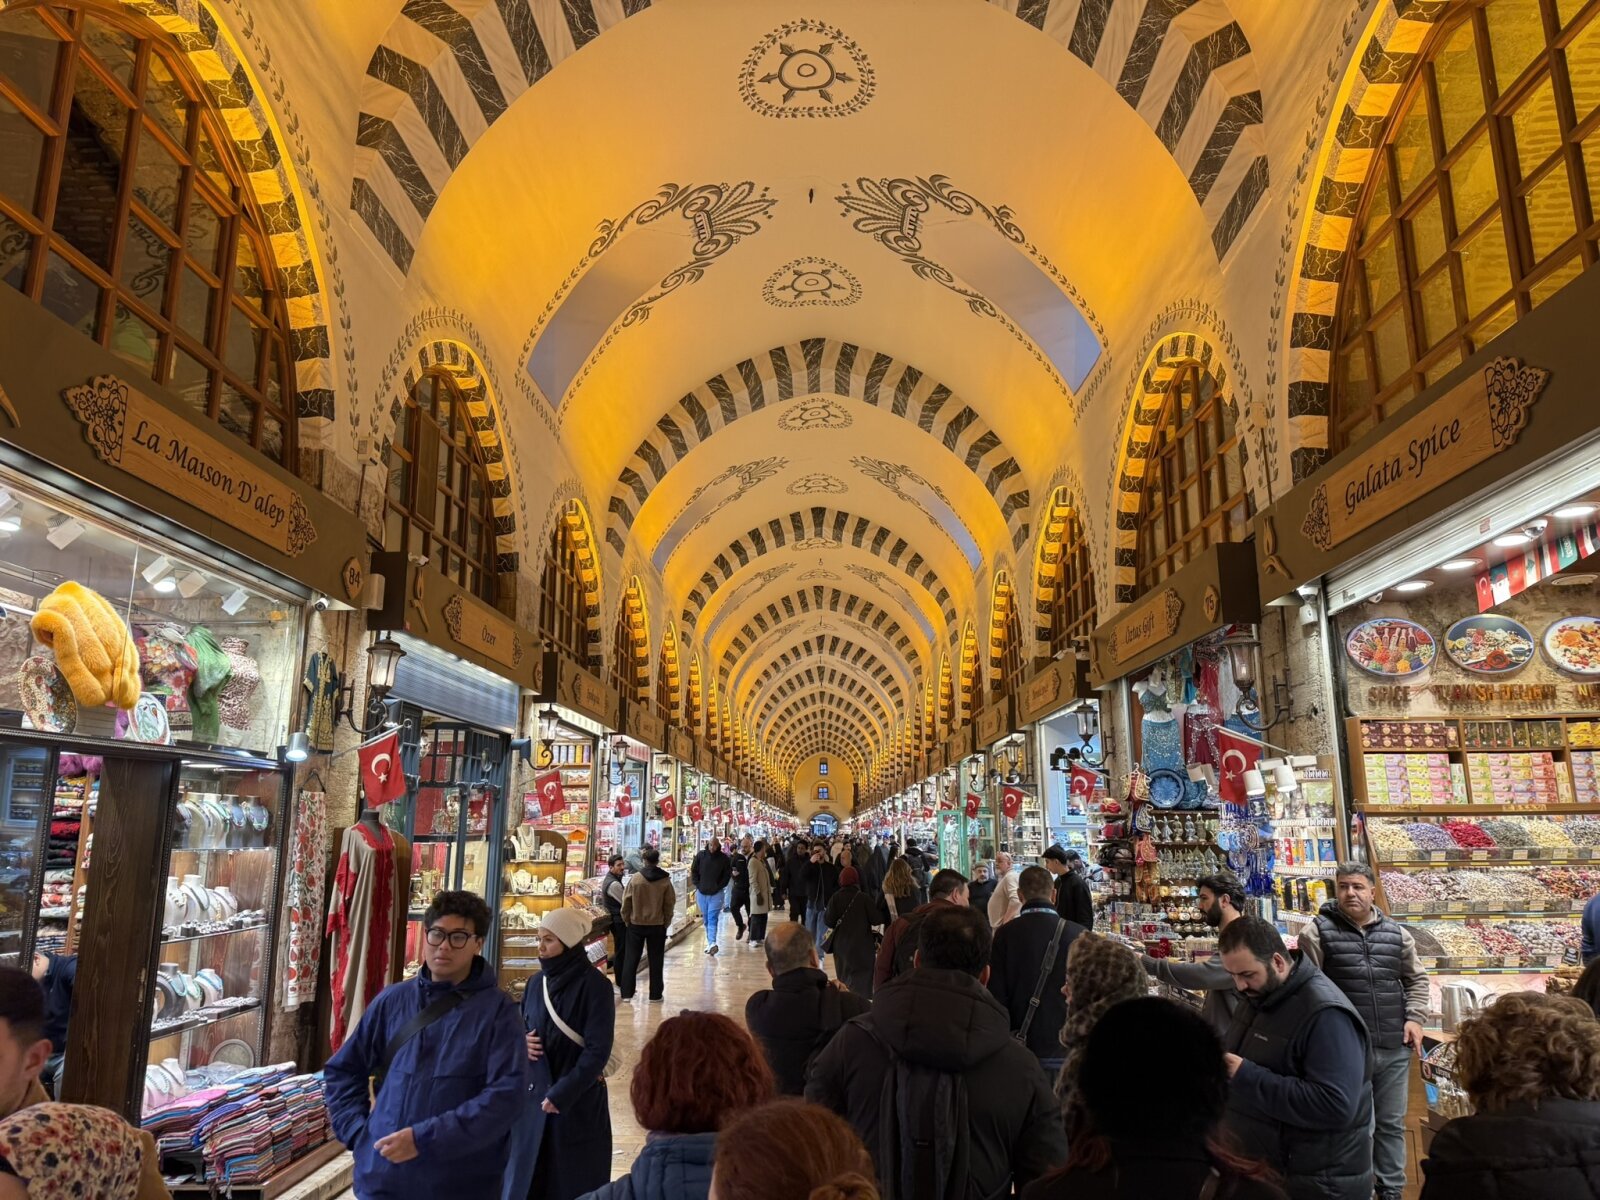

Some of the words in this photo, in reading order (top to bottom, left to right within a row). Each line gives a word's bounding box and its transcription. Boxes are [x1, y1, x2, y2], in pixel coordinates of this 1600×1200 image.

[131, 420, 161, 454] La
[1345, 457, 1403, 515] Galata
[1407, 417, 1461, 479] Spice
[348, 567, 361, 589] 84
[1205, 593, 1215, 615] 75
[1368, 685, 1411, 704] SPICE
